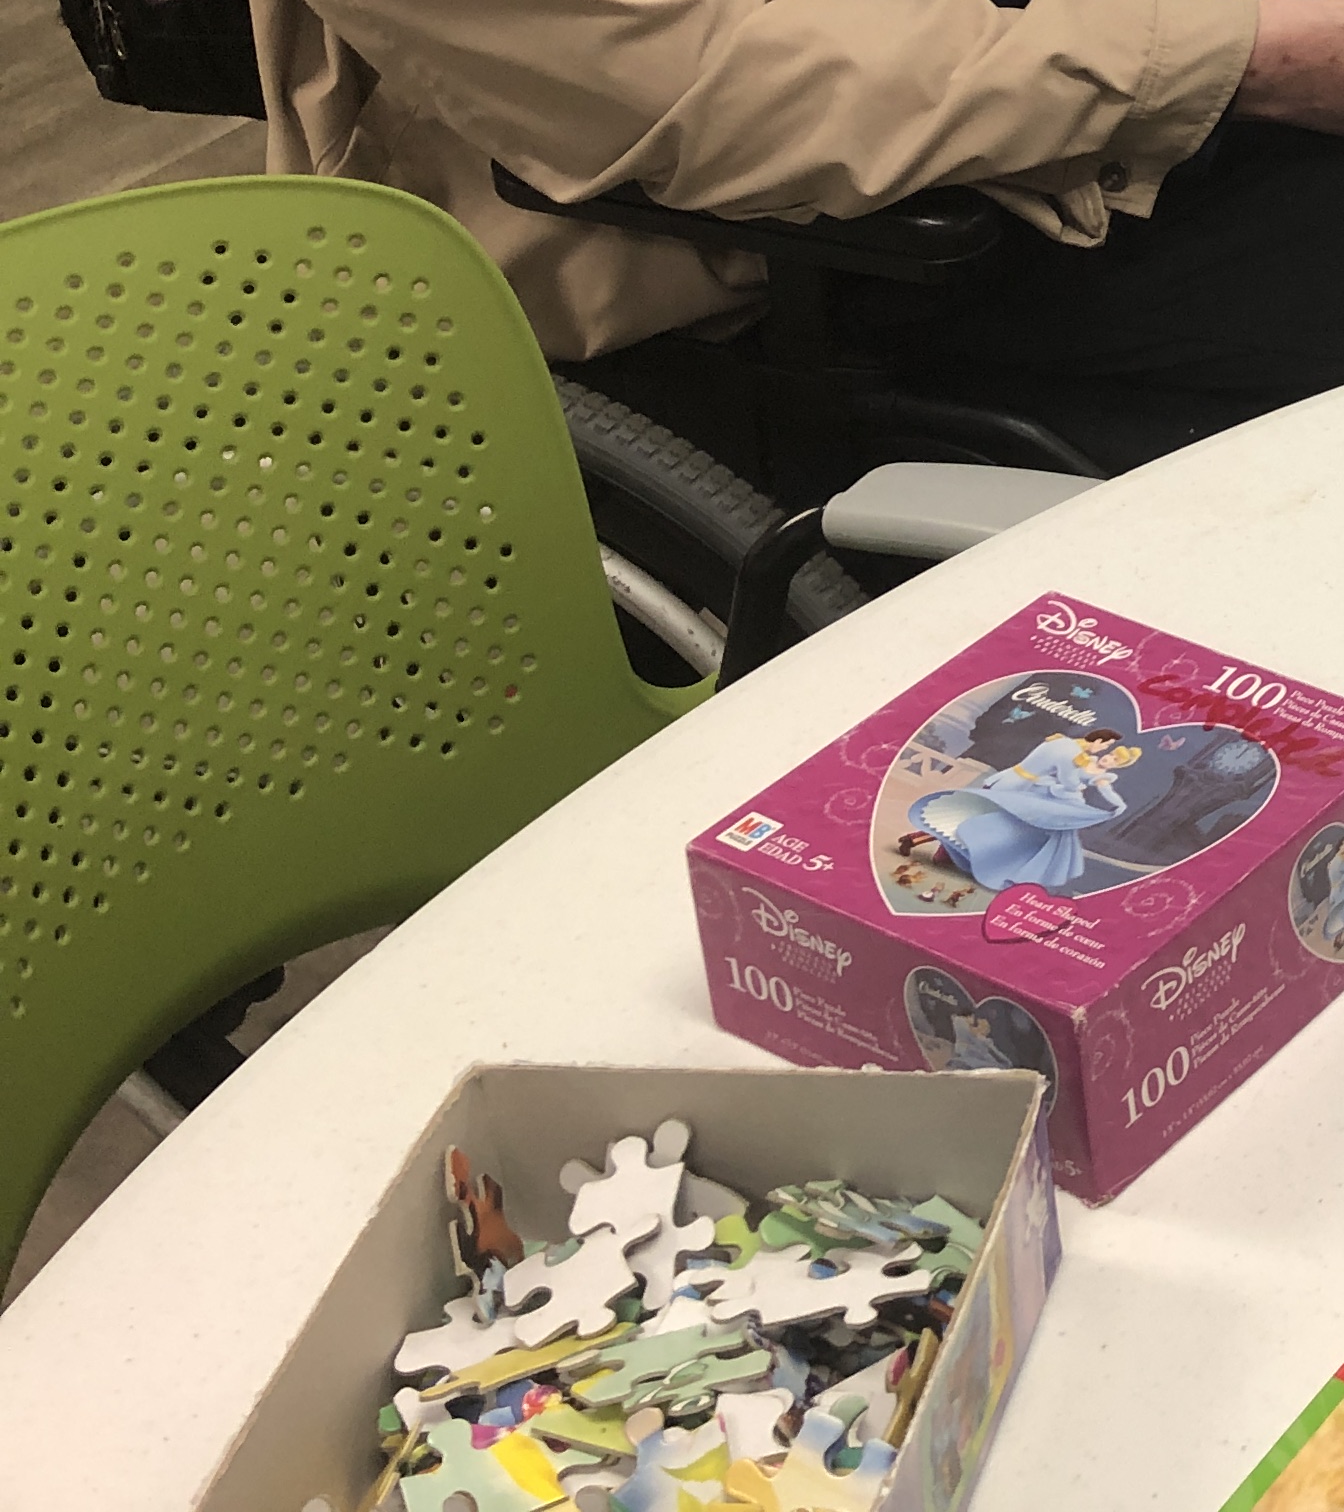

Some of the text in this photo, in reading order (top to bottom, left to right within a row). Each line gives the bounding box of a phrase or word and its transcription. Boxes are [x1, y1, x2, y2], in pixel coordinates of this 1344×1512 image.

[1011, 682, 1099, 728] Cinderella
[1202, 665, 1288, 710] 100
[757, 841, 835, 871] EDAD 5+
[771, 834, 810, 853] AGE
[1004, 903, 1024, 918] En
[1023, 910, 1060, 931] forme
[1058, 925, 1074, 938] de
[1019, 892, 1102, 930] Heart Shaped
[989, 914, 1009, 929] En
[1008, 921, 1044, 944] forma
[1043, 936, 1060, 949] de
[724, 955, 794, 1014] 100
[1121, 1046, 1191, 1129] 100
